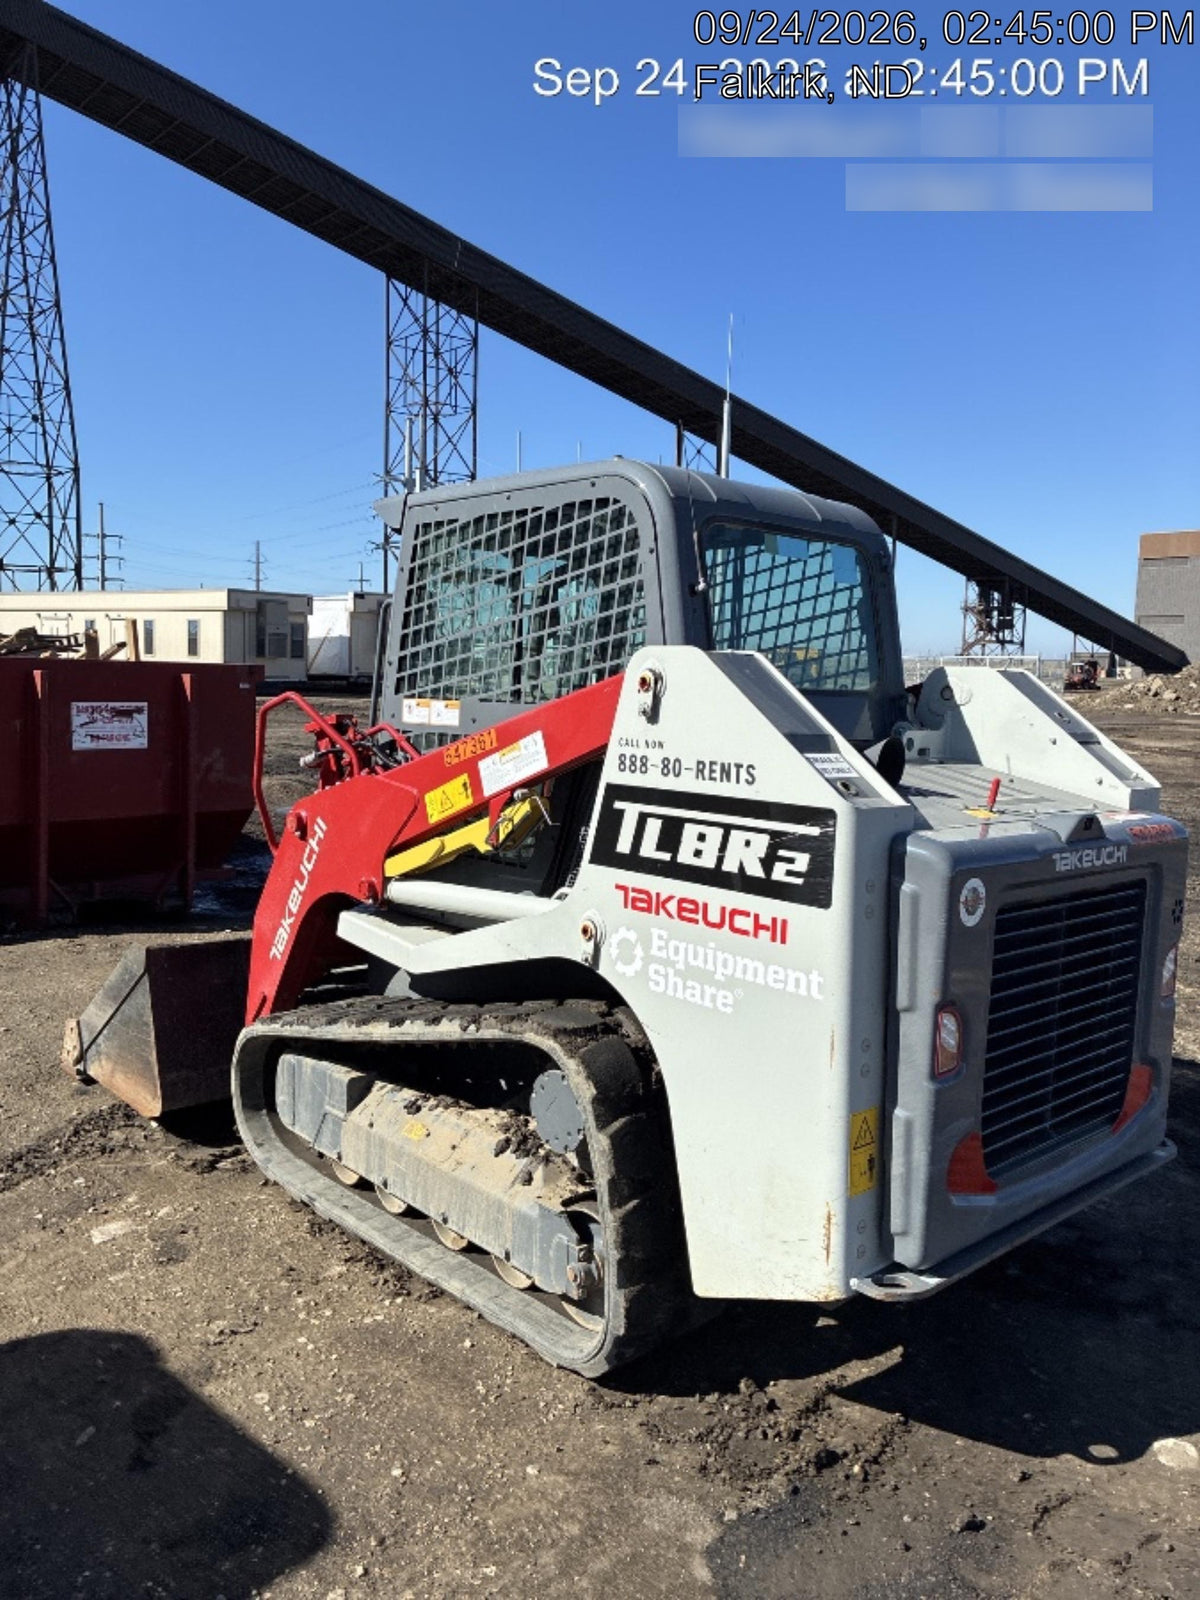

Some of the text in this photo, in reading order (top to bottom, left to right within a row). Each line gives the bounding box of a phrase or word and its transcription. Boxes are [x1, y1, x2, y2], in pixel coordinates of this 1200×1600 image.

[618, 737, 665, 750] CALL NOW
[618, 753, 757, 785] 888-80-RENTS
[613, 800, 822, 885] TL8R2
[649, 926, 824, 1001] Equipment
